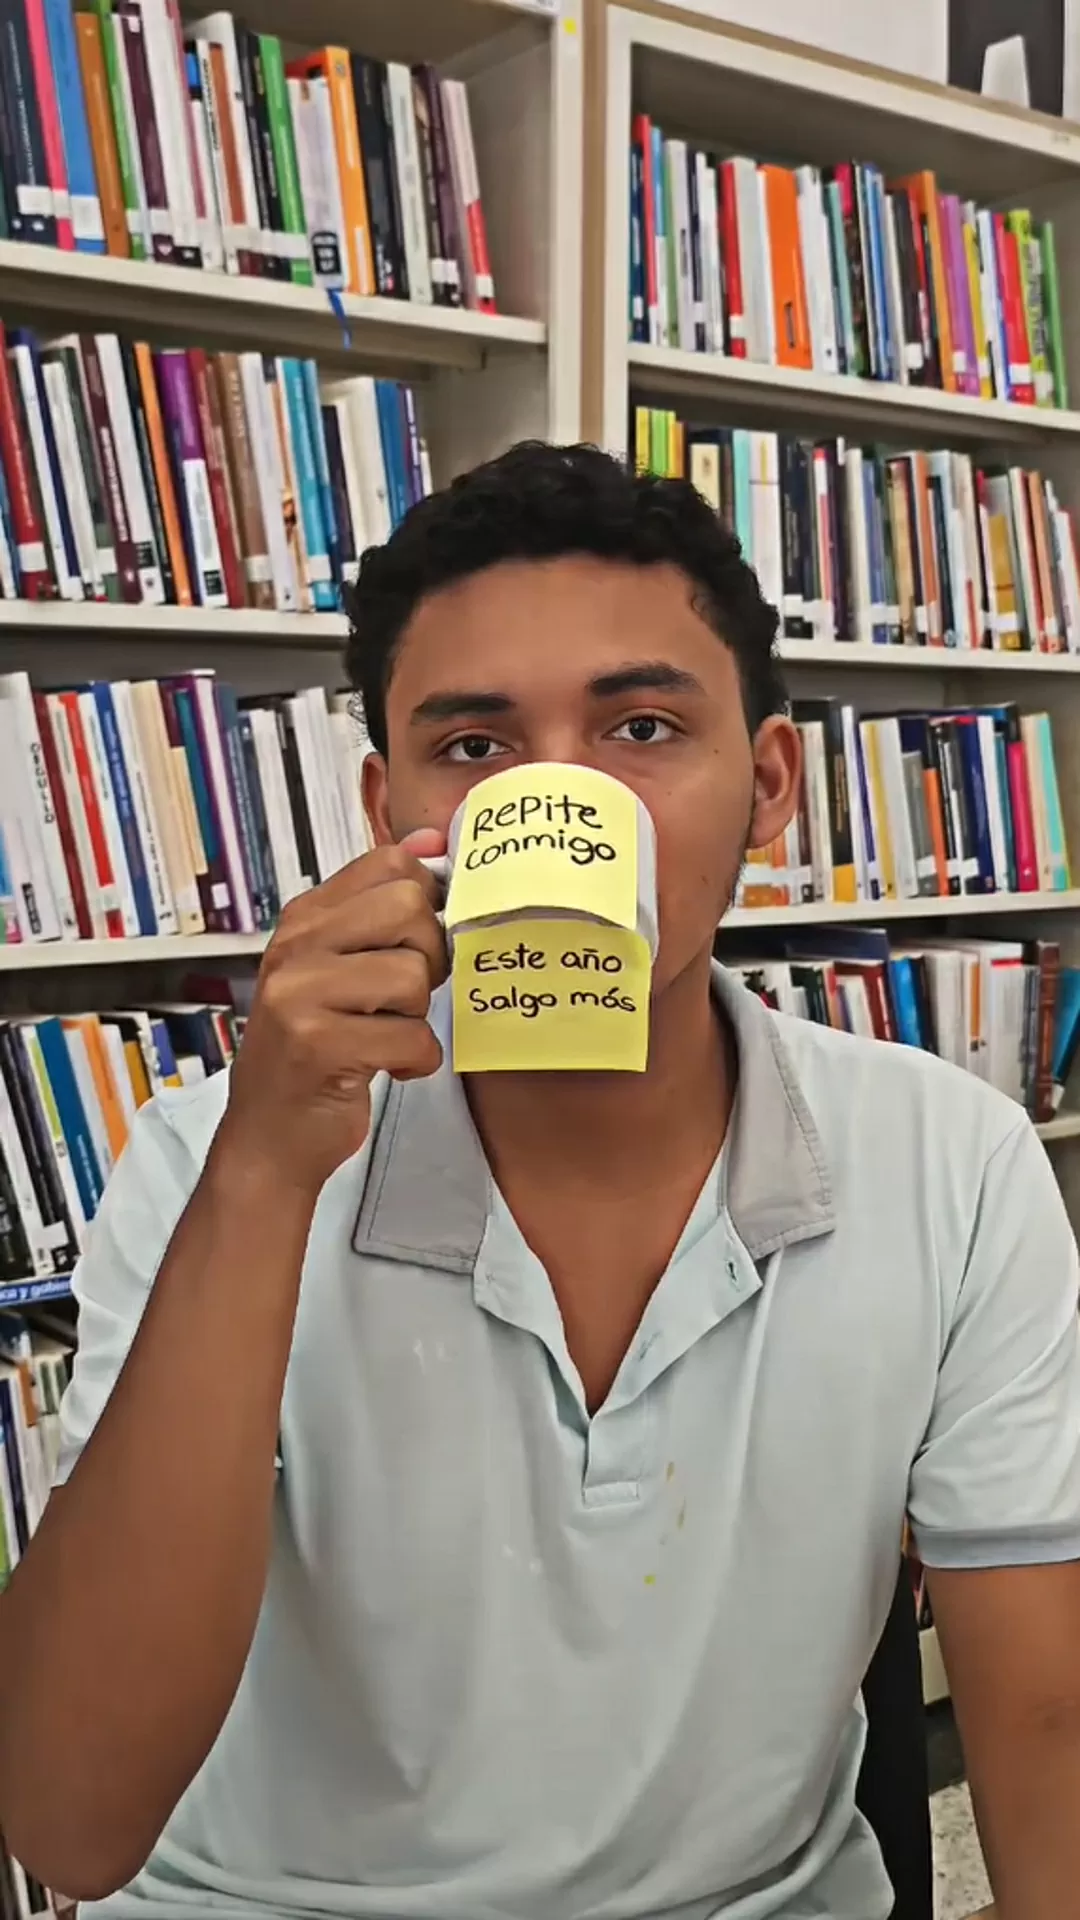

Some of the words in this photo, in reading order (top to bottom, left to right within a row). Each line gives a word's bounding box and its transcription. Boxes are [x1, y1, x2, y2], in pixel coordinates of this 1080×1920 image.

[464, 828, 617, 871] conmigo
[473, 942, 547, 973] Este
[560, 946, 623, 974] año
[468, 985, 559, 1018] Salgo
[570, 986, 638, 1013] más
